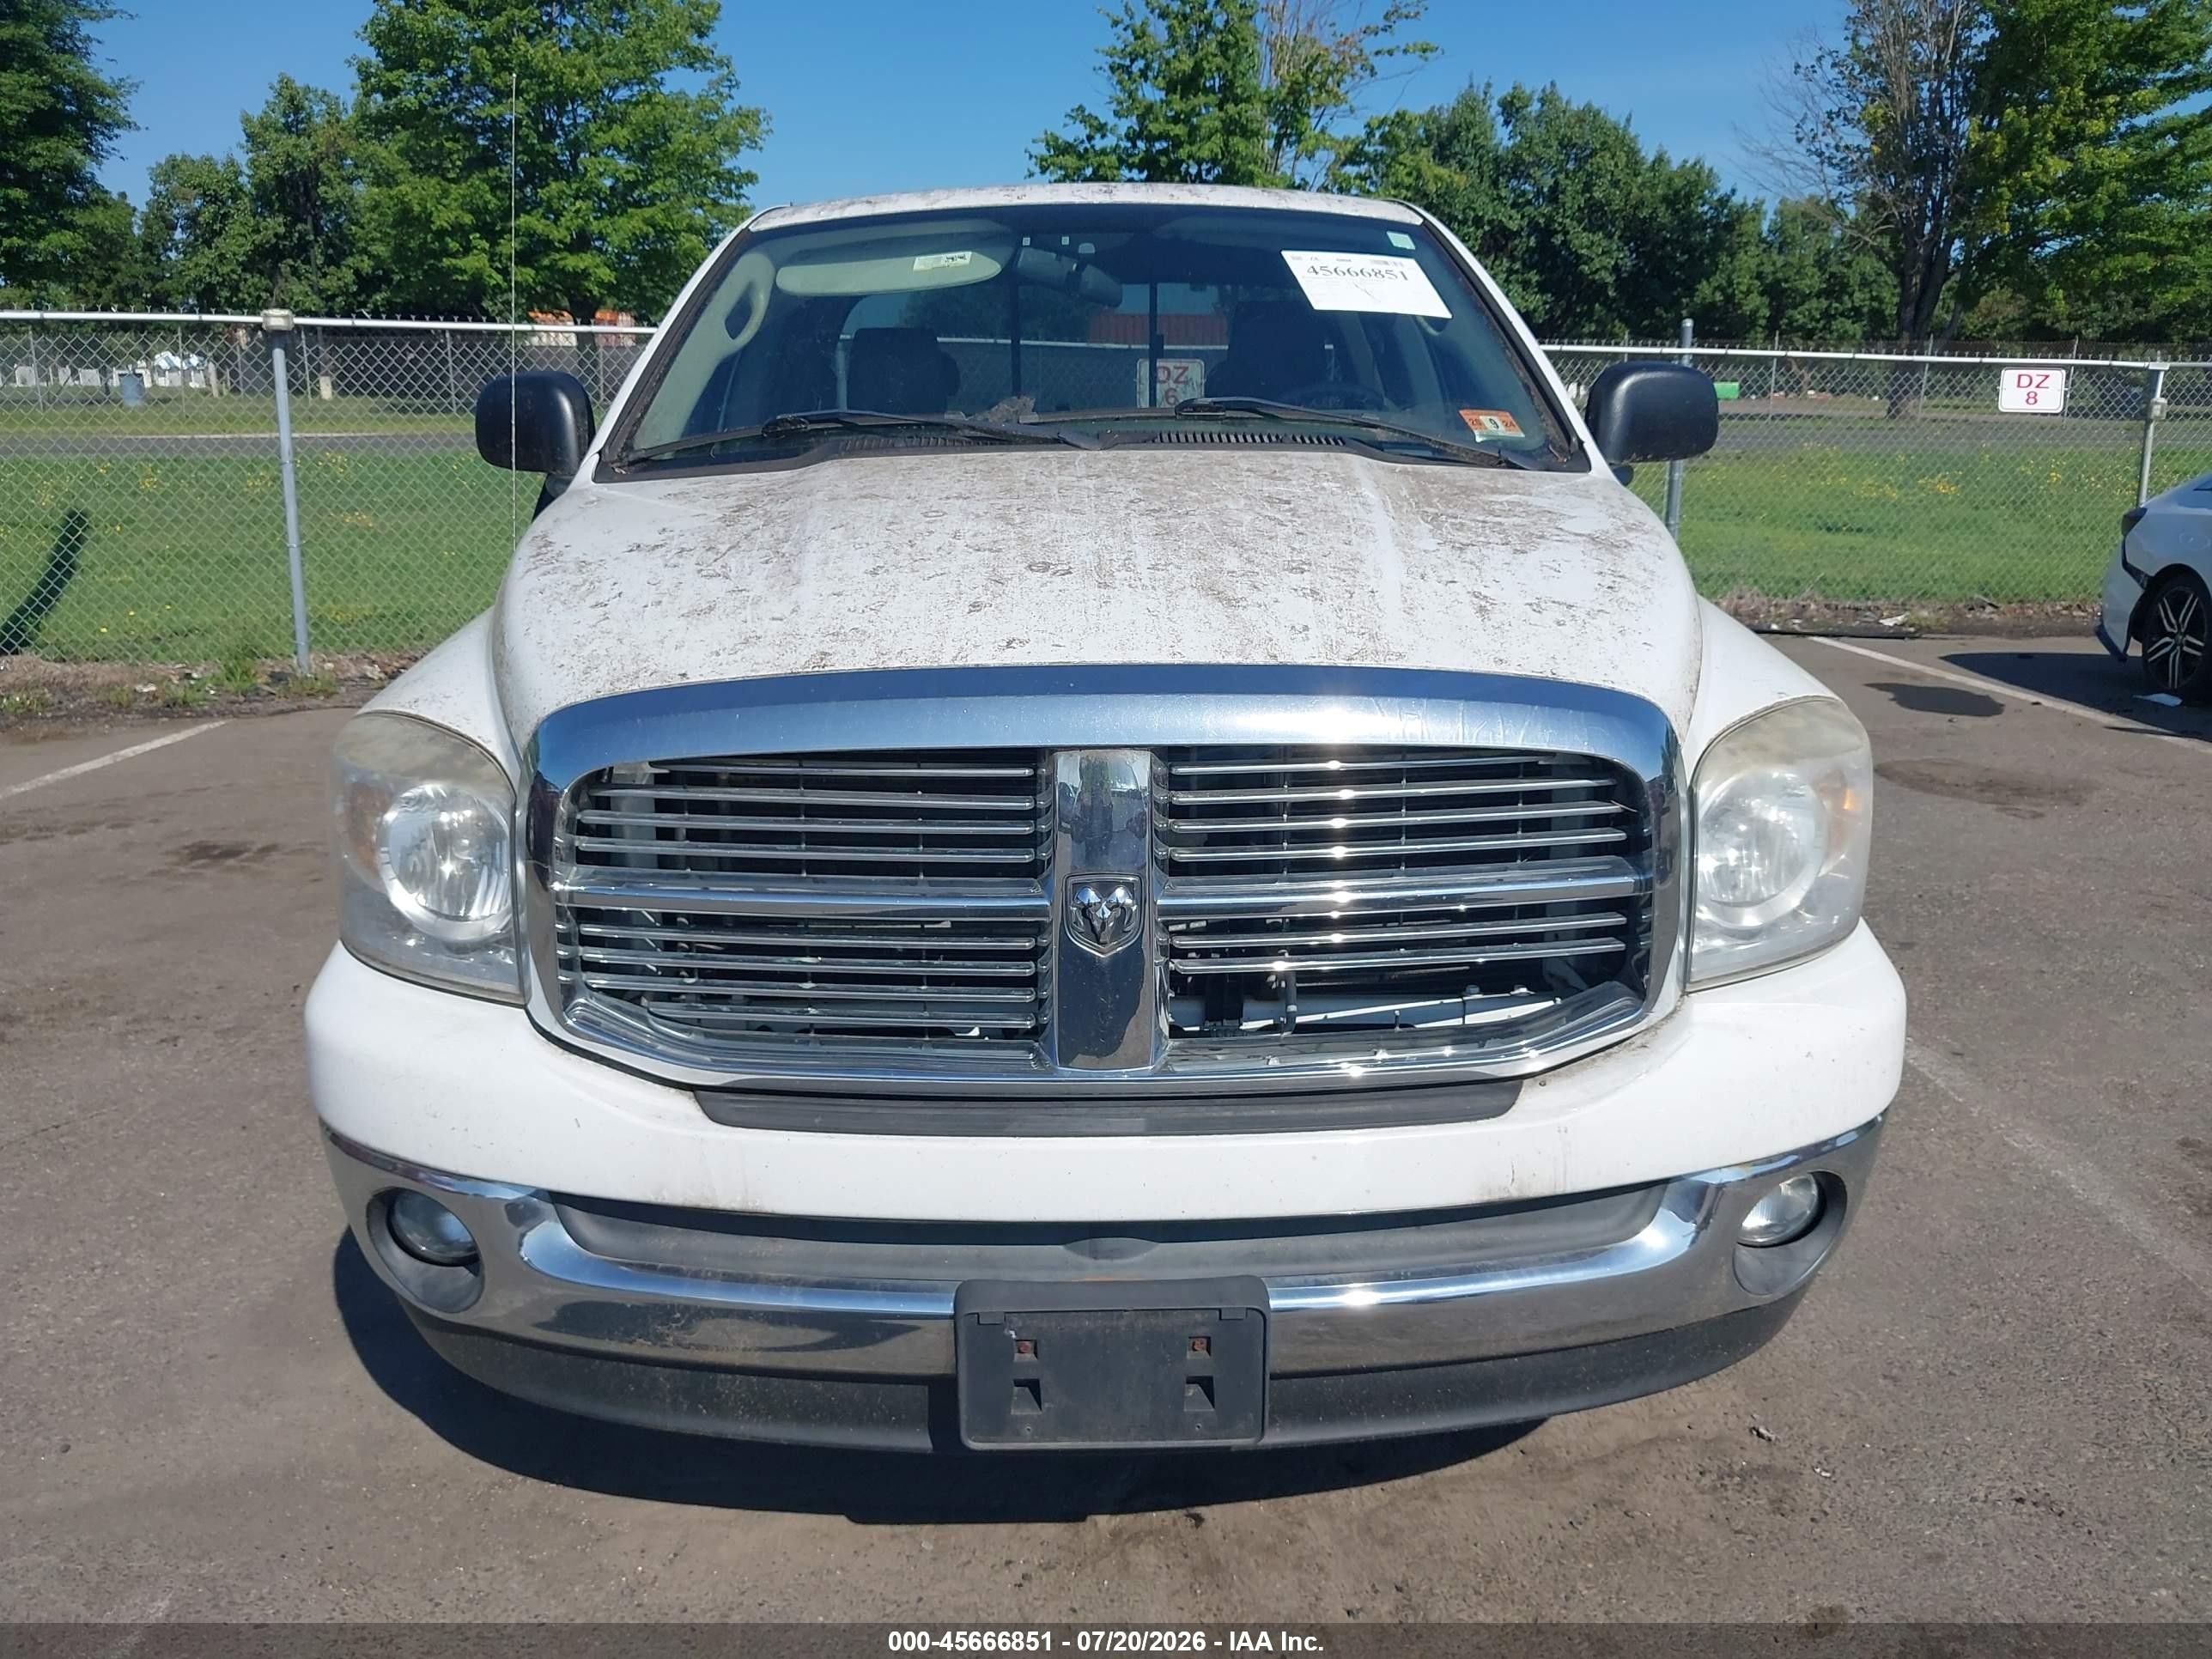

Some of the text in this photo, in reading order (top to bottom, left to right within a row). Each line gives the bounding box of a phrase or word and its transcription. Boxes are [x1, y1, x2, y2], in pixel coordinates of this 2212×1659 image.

[1307, 264, 1409, 282] 45666851
[1157, 365, 1189, 385] DZ
[2016, 374, 2051, 389] DZ
[2025, 391, 2039, 405] 8
[1488, 418, 1499, 429] 9
